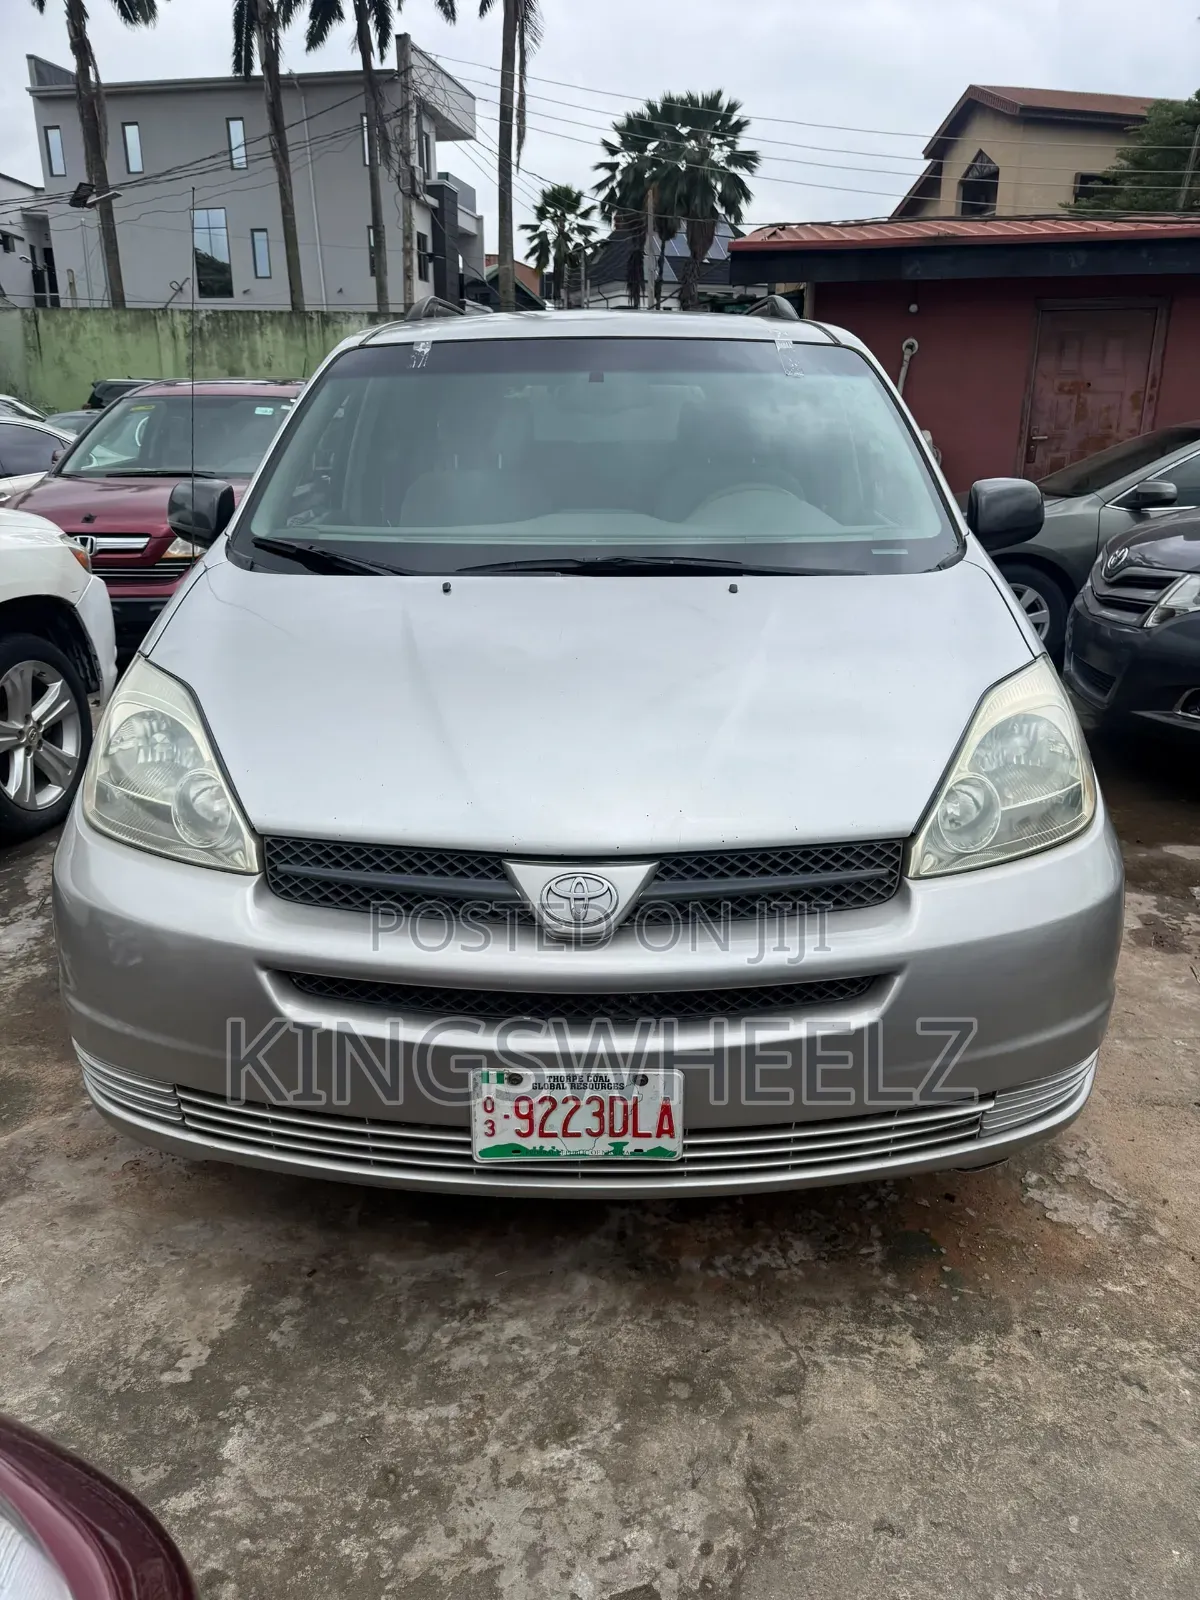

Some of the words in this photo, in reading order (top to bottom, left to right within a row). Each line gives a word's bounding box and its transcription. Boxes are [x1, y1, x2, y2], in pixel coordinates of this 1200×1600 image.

[546, 1075, 584, 1083] THORPE
[586, 1075, 610, 1083] COAL
[531, 1082, 567, 1091] GLOBAL
[569, 1082, 625, 1091] RESOURCES
